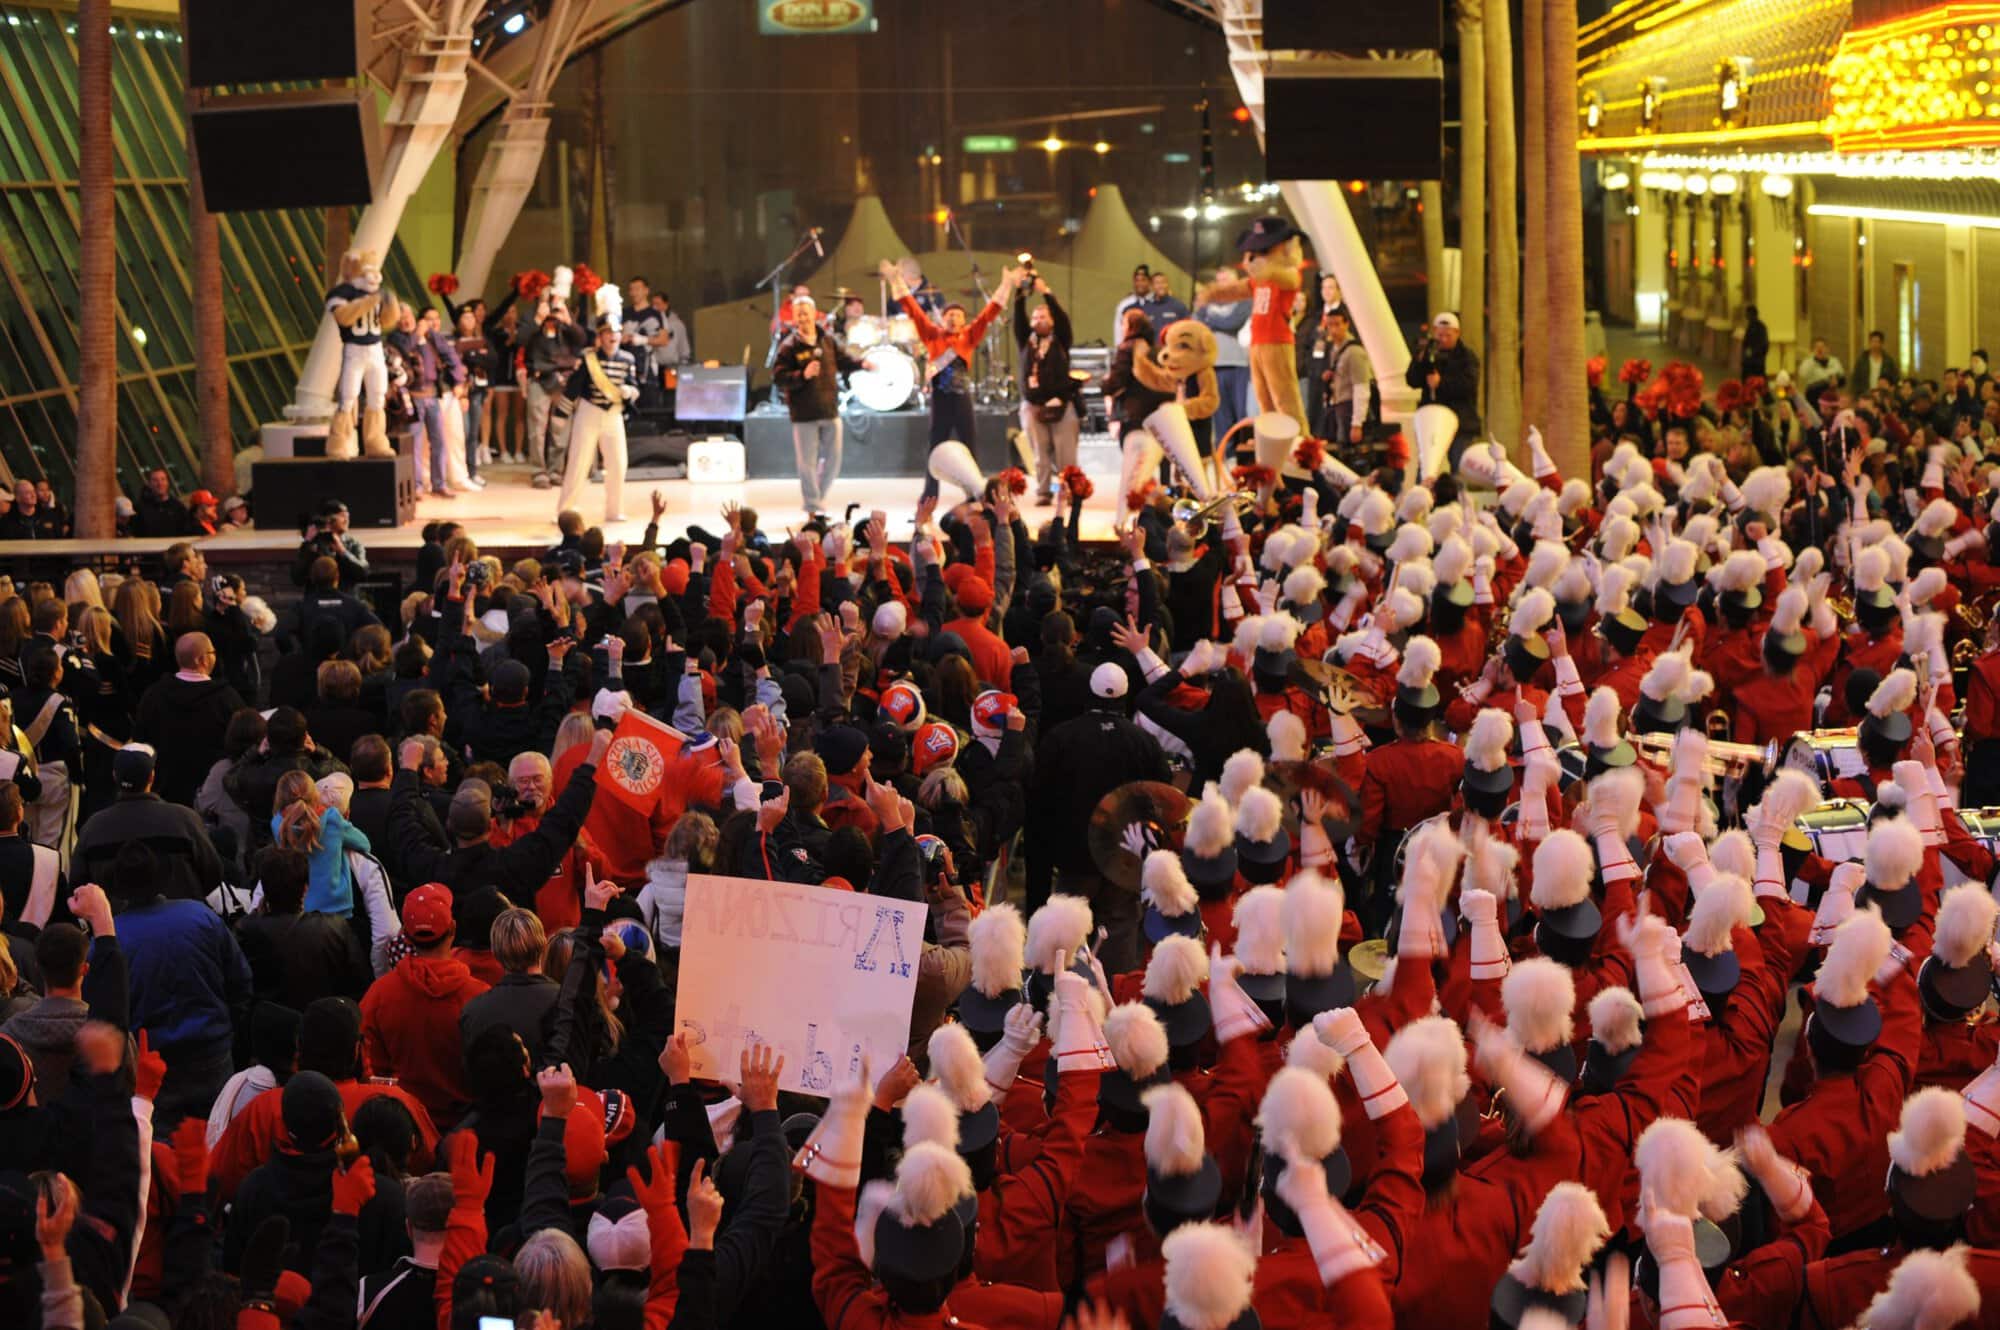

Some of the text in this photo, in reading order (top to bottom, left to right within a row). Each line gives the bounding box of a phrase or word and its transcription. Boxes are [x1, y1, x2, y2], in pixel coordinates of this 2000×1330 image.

[608, 738, 643, 780] ARIZONA
[925, 727, 955, 753] A
[628, 743, 663, 793] WILDCATS
